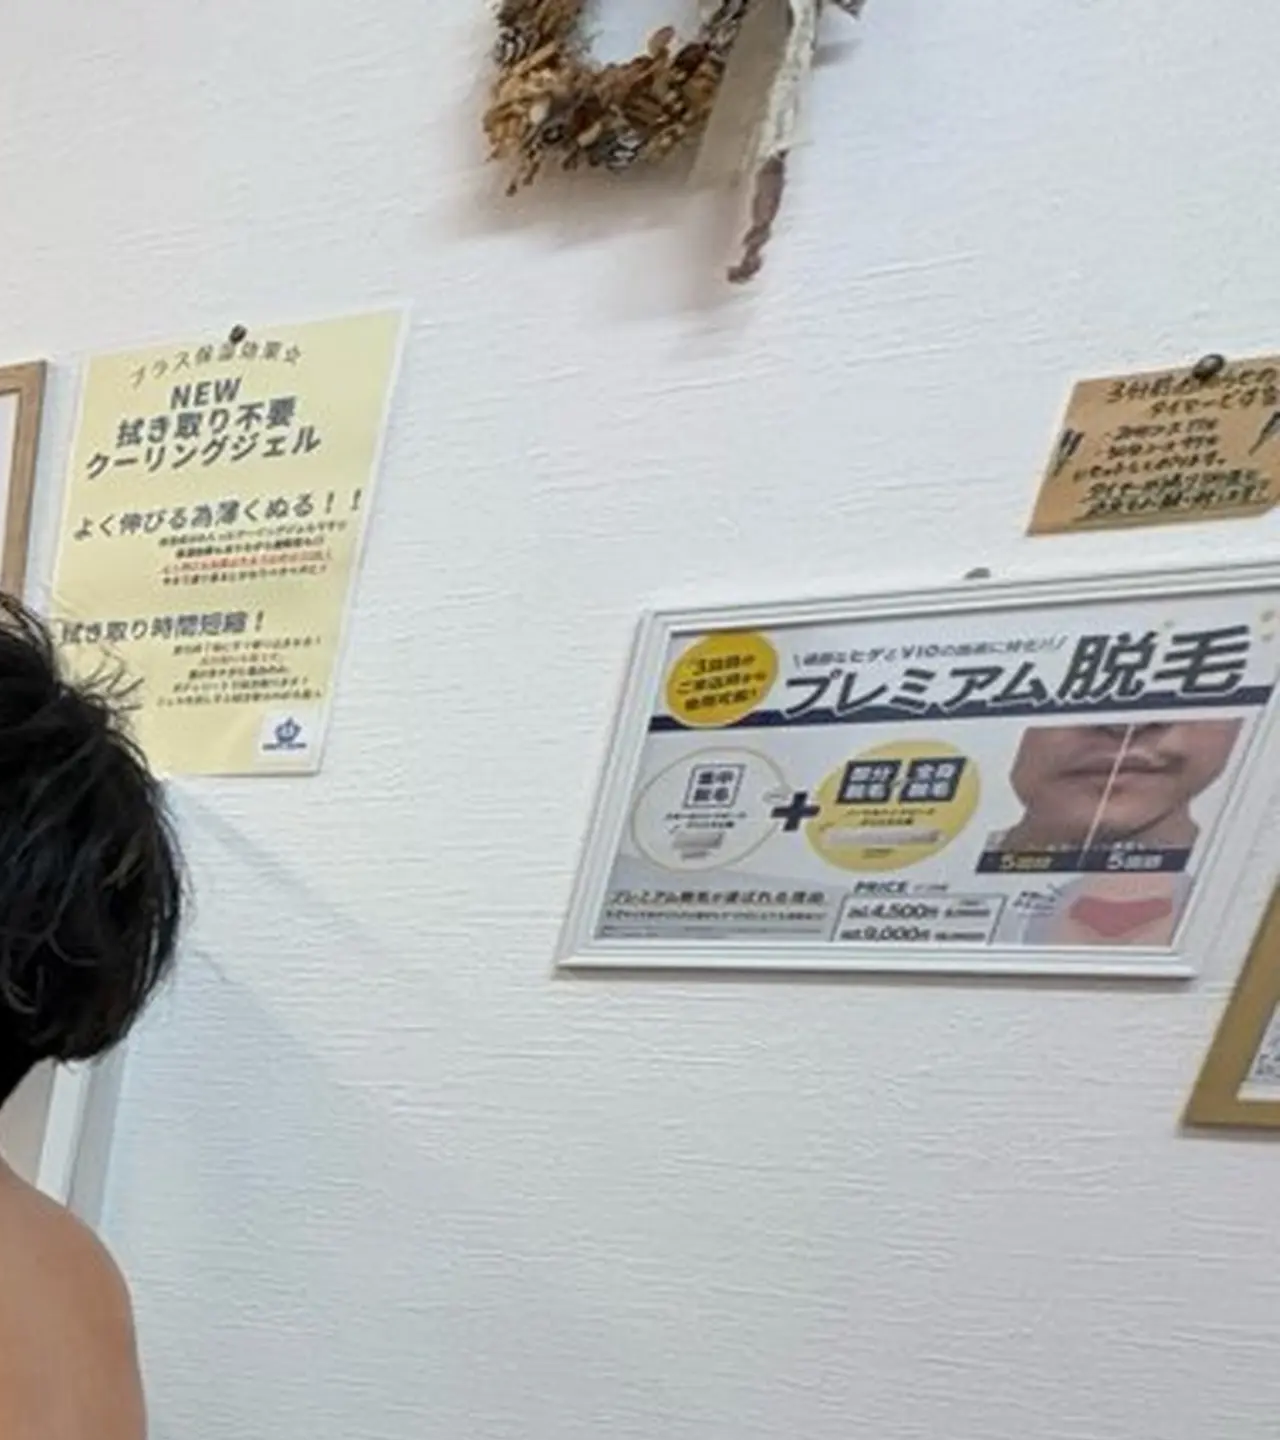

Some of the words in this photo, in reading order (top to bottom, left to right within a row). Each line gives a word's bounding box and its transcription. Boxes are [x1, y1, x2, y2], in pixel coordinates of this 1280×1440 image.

[169, 377, 242, 410] NEW
[115, 396, 297, 449] 拭き取り不要
[86, 425, 322, 480] クーリングジェル
[61, 610, 265, 646] 拭き取り時間短縮！
[785, 624, 1250, 716] プレミアム脱毛
